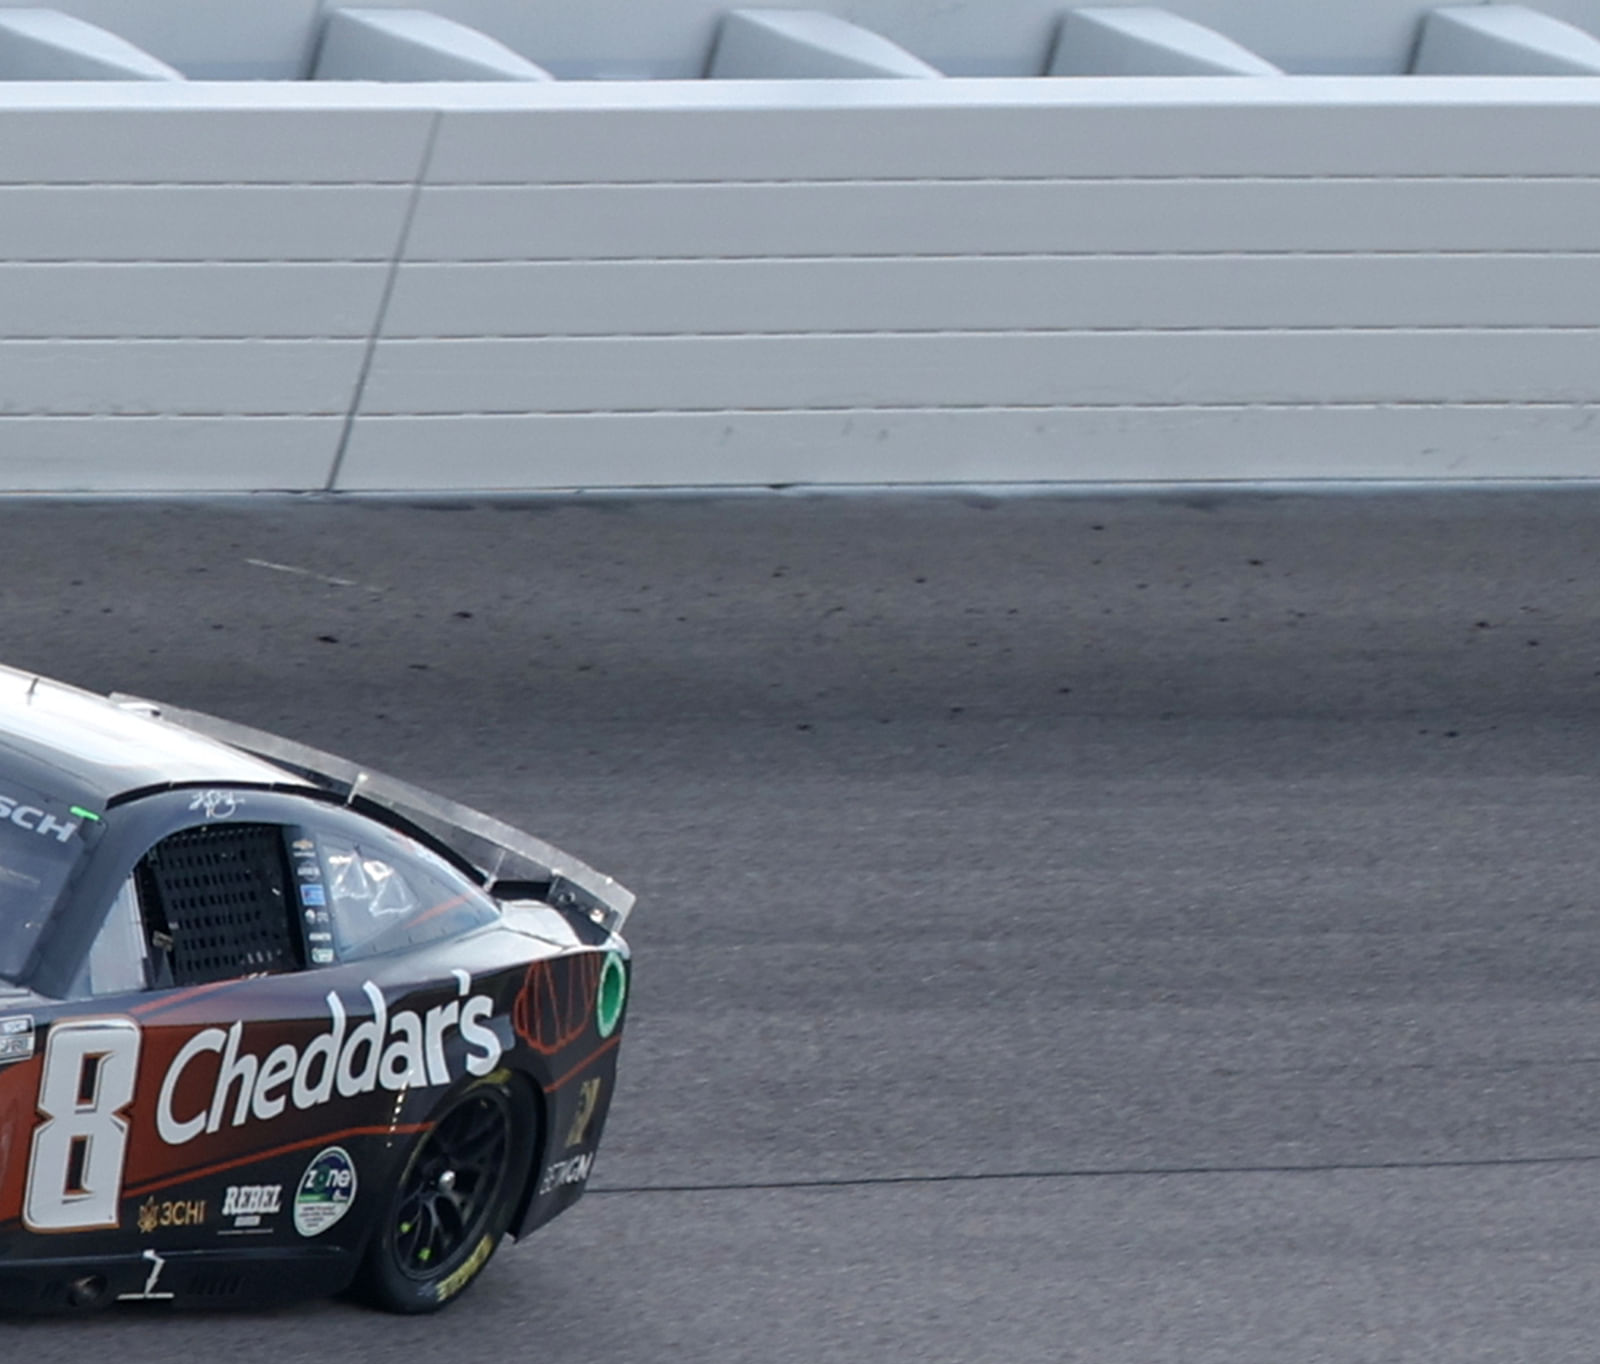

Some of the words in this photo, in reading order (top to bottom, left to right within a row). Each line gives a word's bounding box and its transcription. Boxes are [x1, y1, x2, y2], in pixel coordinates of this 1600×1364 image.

[156, 968, 502, 1145] Cheddar's
[22, 1014, 141, 1234] 8
[160, 1200, 206, 1225] 3CHI
[222, 1185, 283, 1215] REBEL
